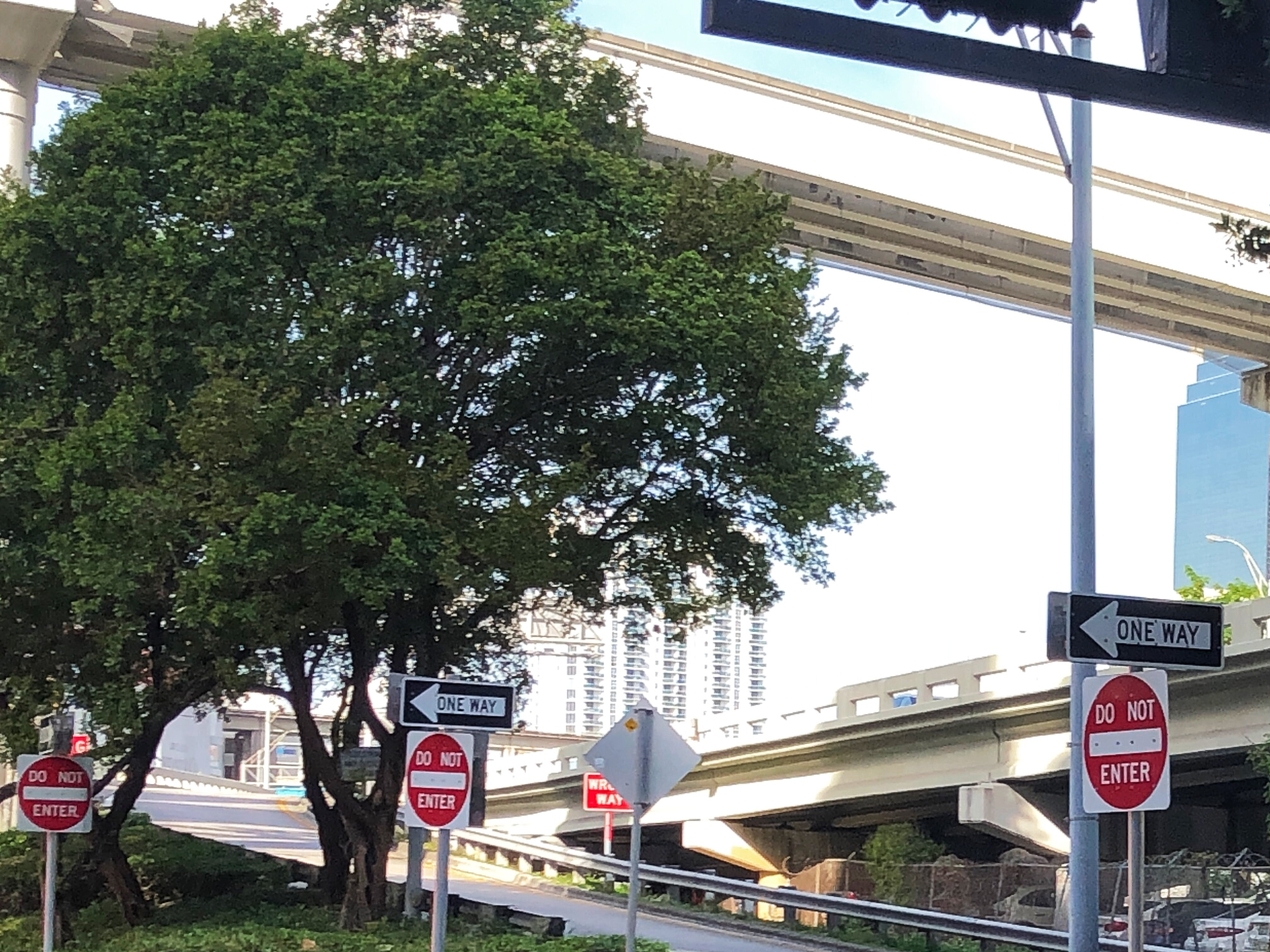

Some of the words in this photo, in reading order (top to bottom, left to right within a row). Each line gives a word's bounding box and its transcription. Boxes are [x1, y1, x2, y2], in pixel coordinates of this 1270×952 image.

[1117, 619, 1156, 642] ONE
[1162, 622, 1200, 645] WAY
[437, 696, 465, 712] ONE
[469, 699, 497, 714] WAY
[1095, 702, 1115, 725] DO
[1127, 699, 1155, 722] NOT
[415, 751, 432, 766] DO
[440, 752, 463, 767] NOT
[28, 770, 48, 783] DO
[58, 771, 84, 784] NOT
[1101, 761, 1150, 785] ENTER
[417, 793, 456, 810] ENTER
[596, 793, 623, 806] WAY
[32, 804, 79, 818] ENTER
